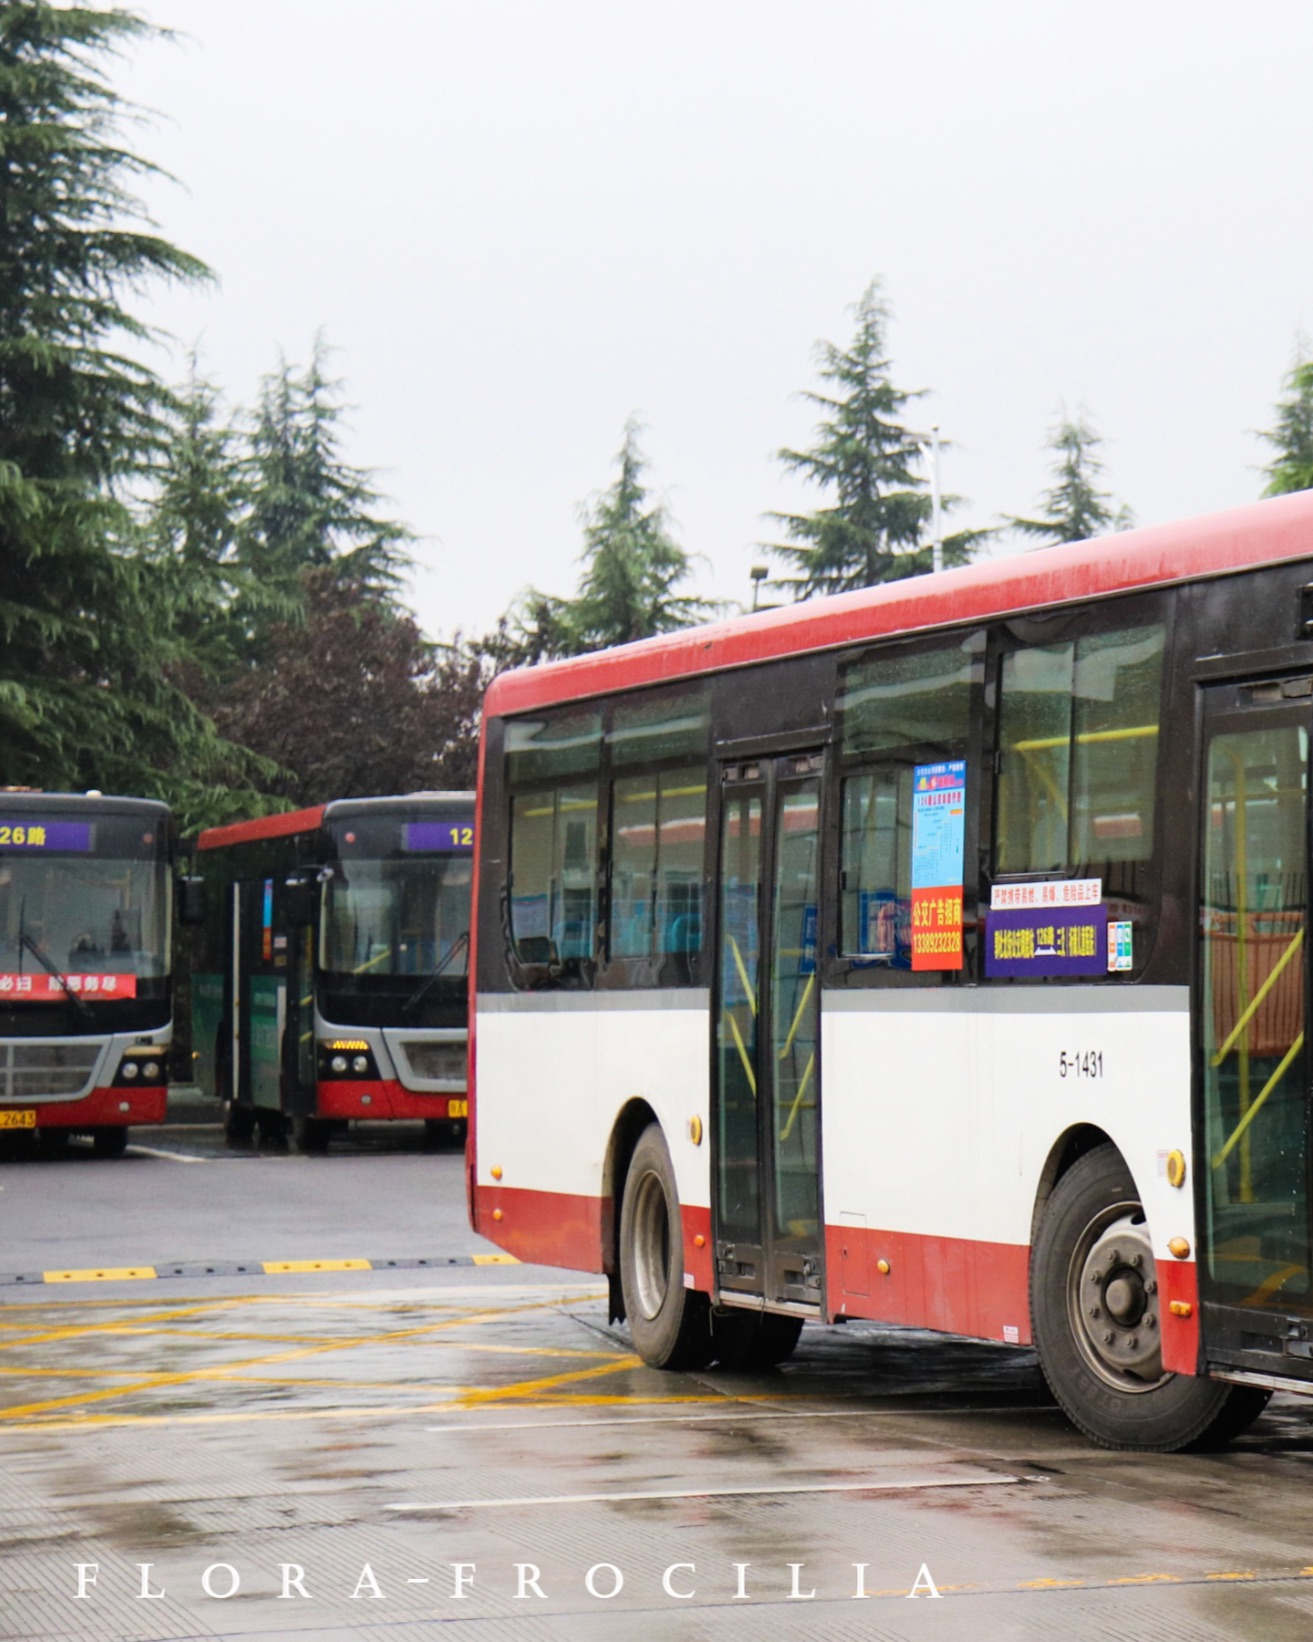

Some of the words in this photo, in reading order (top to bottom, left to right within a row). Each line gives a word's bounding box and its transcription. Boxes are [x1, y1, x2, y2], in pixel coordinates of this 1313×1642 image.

[913, 897, 962, 926] 公交广告招商
[1060, 1051, 1103, 1078] 5-1431
[0, 1113, 34, 1126] 2643
